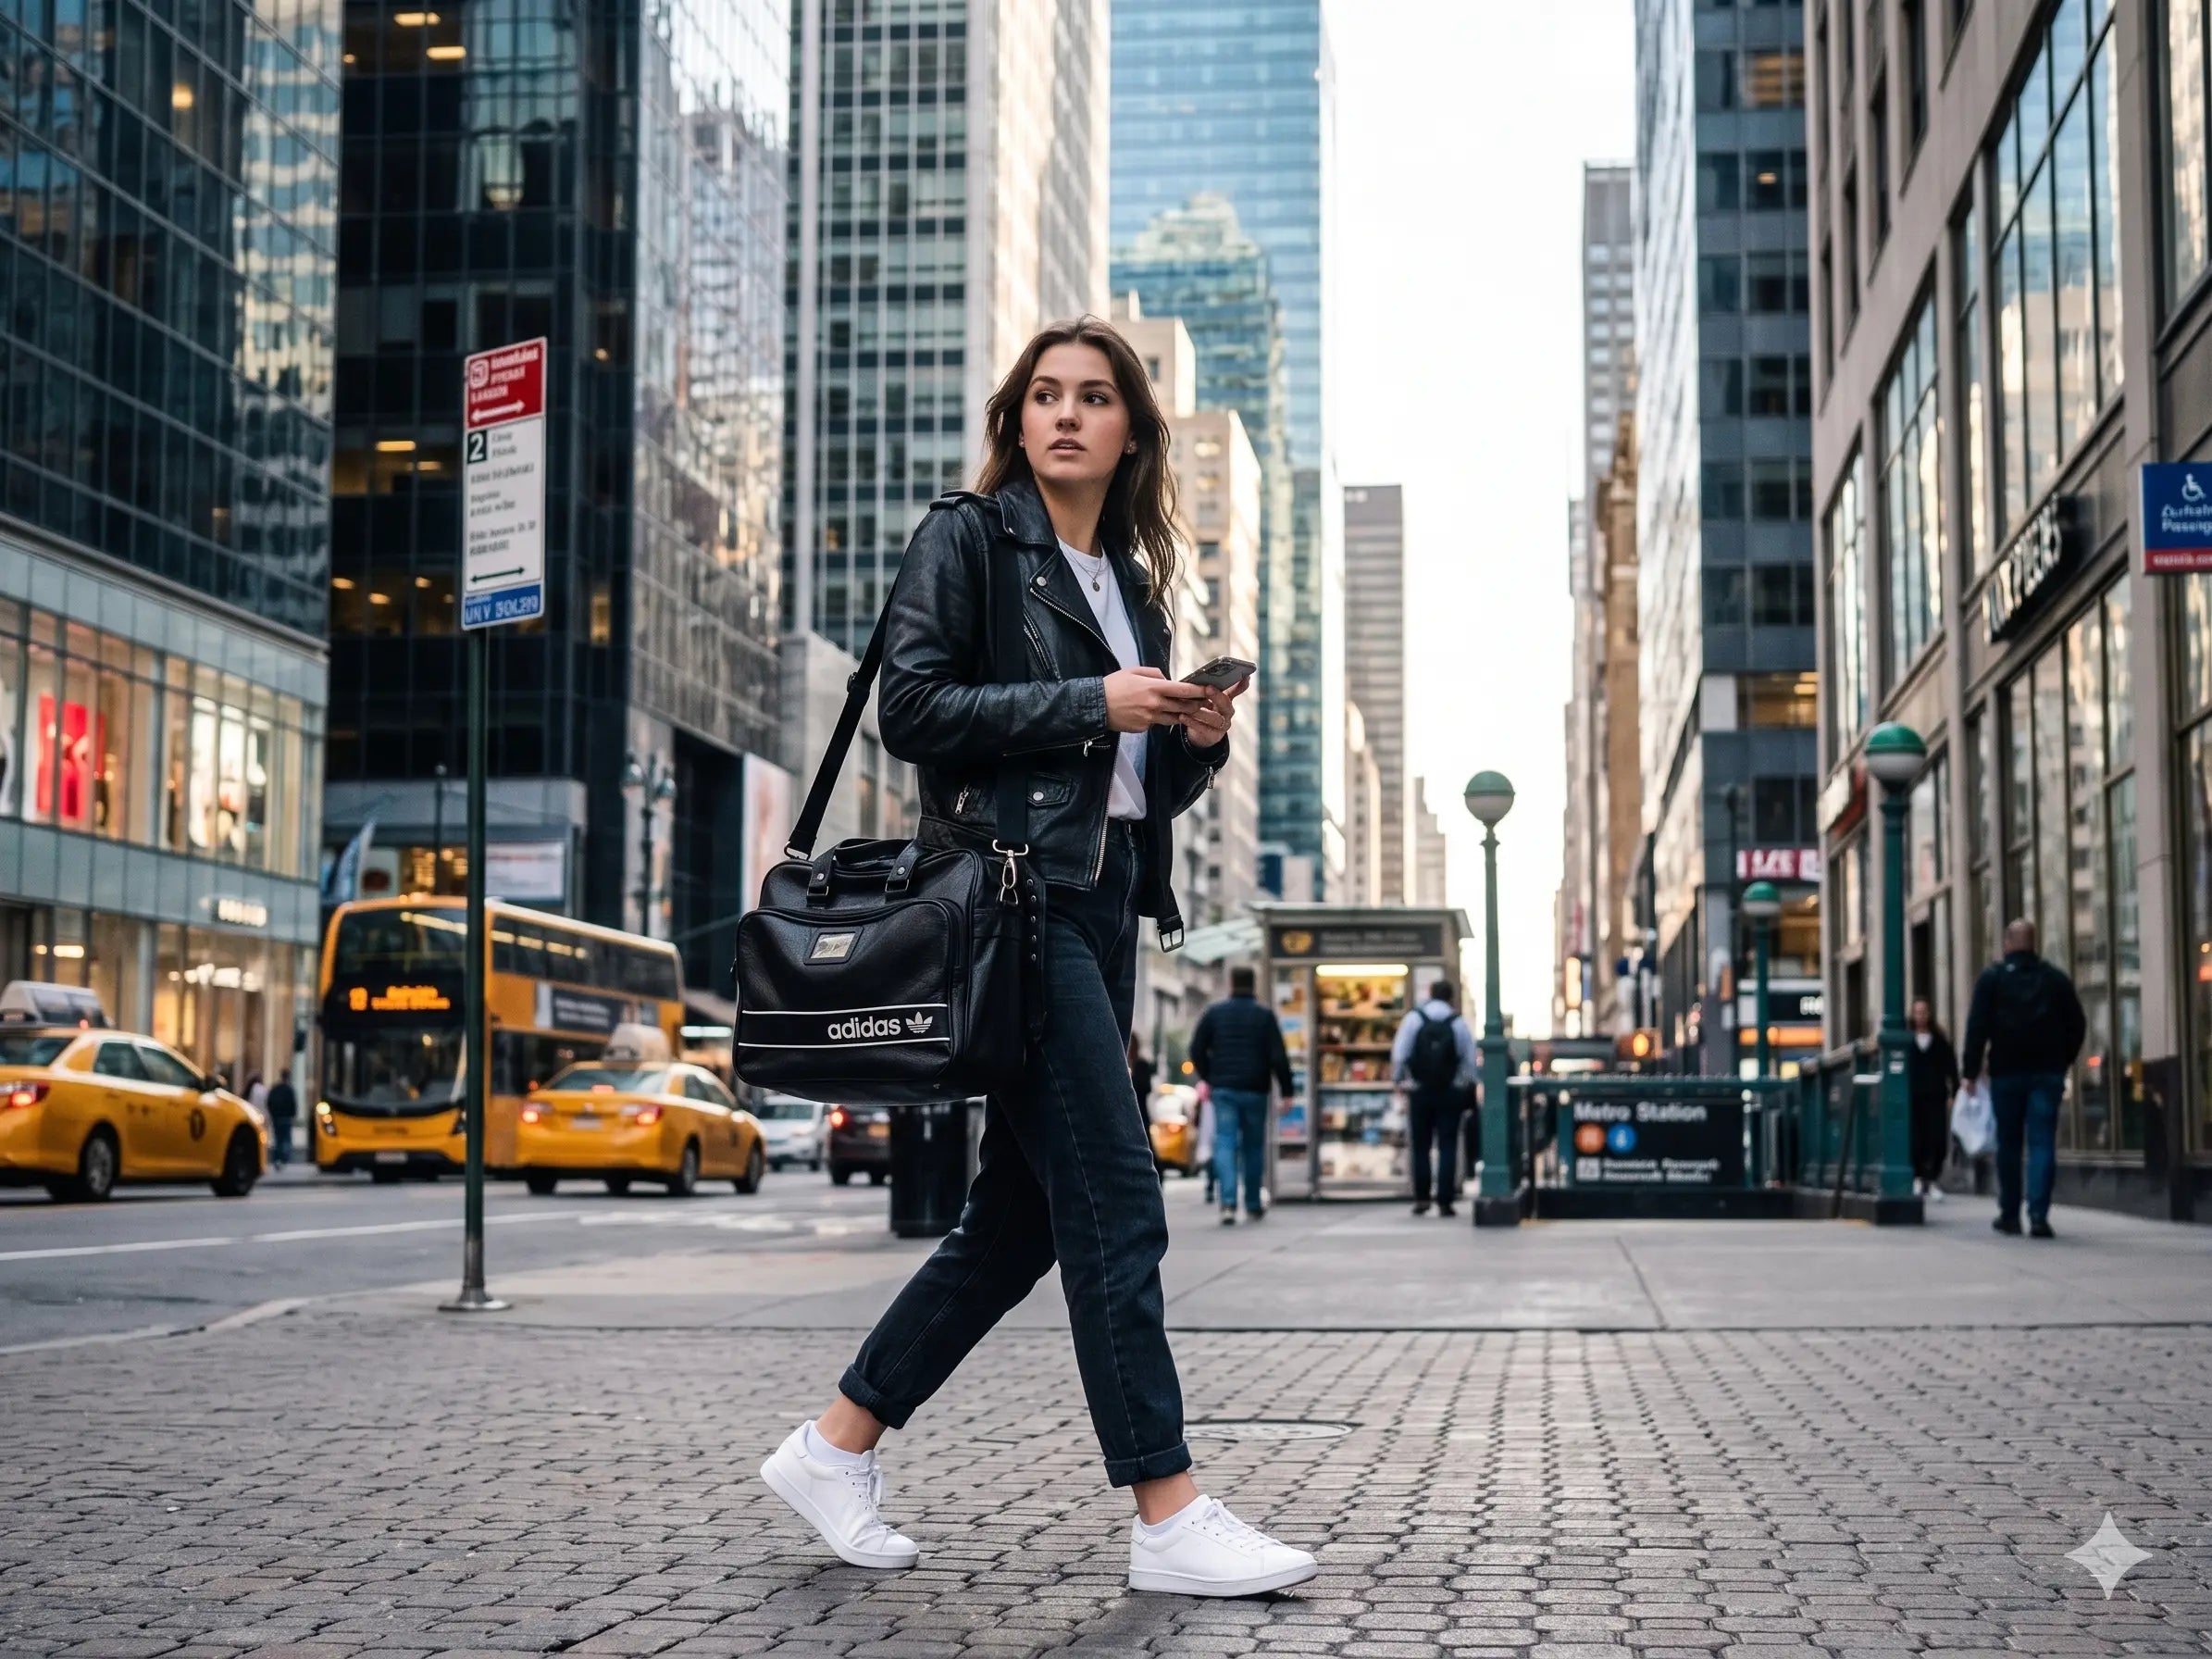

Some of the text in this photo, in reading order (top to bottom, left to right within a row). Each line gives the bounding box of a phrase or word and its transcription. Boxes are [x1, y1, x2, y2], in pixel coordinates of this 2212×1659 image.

[469, 432, 484, 462] 2
[827, 1016, 901, 1040] adidas
[1574, 1101, 1708, 1121] Metro Station
